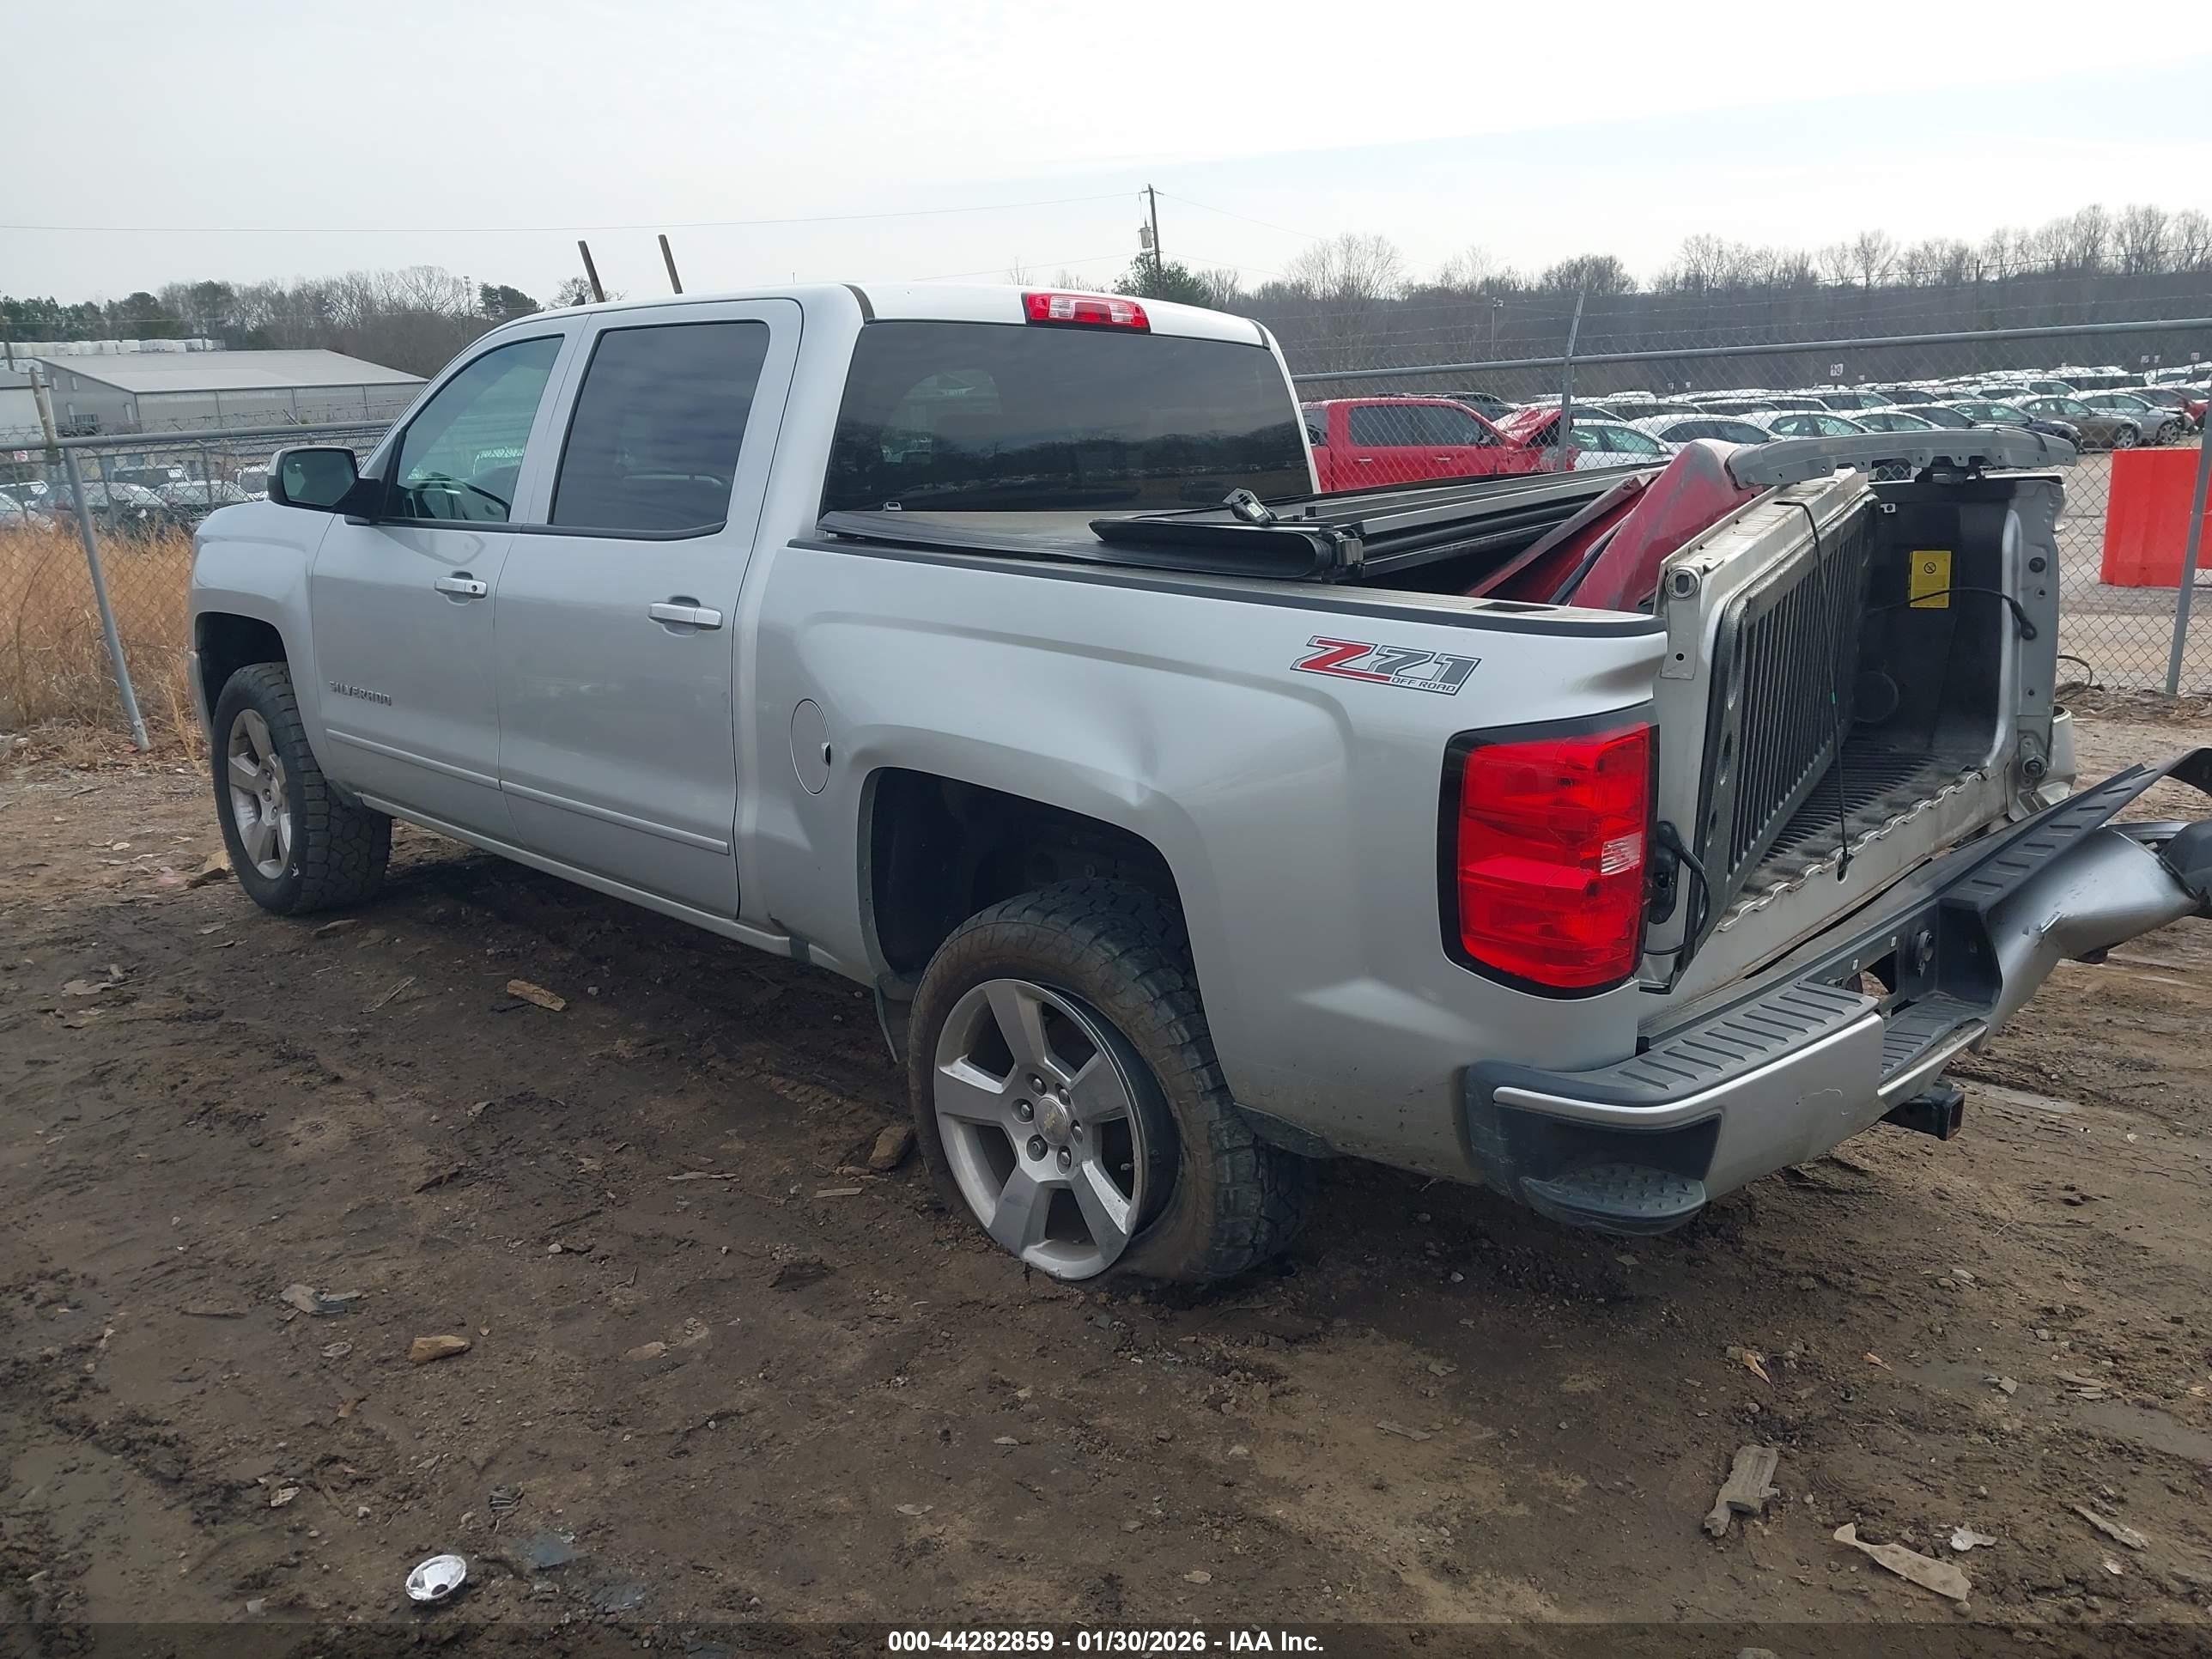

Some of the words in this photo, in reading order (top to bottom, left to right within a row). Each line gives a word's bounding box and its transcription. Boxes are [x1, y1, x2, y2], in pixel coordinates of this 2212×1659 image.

[1290, 635, 1483, 690] Z71
[329, 680, 392, 707] SILVERADO
[1391, 676, 1417, 686] OFF
[1418, 680, 1456, 692] ROAD
